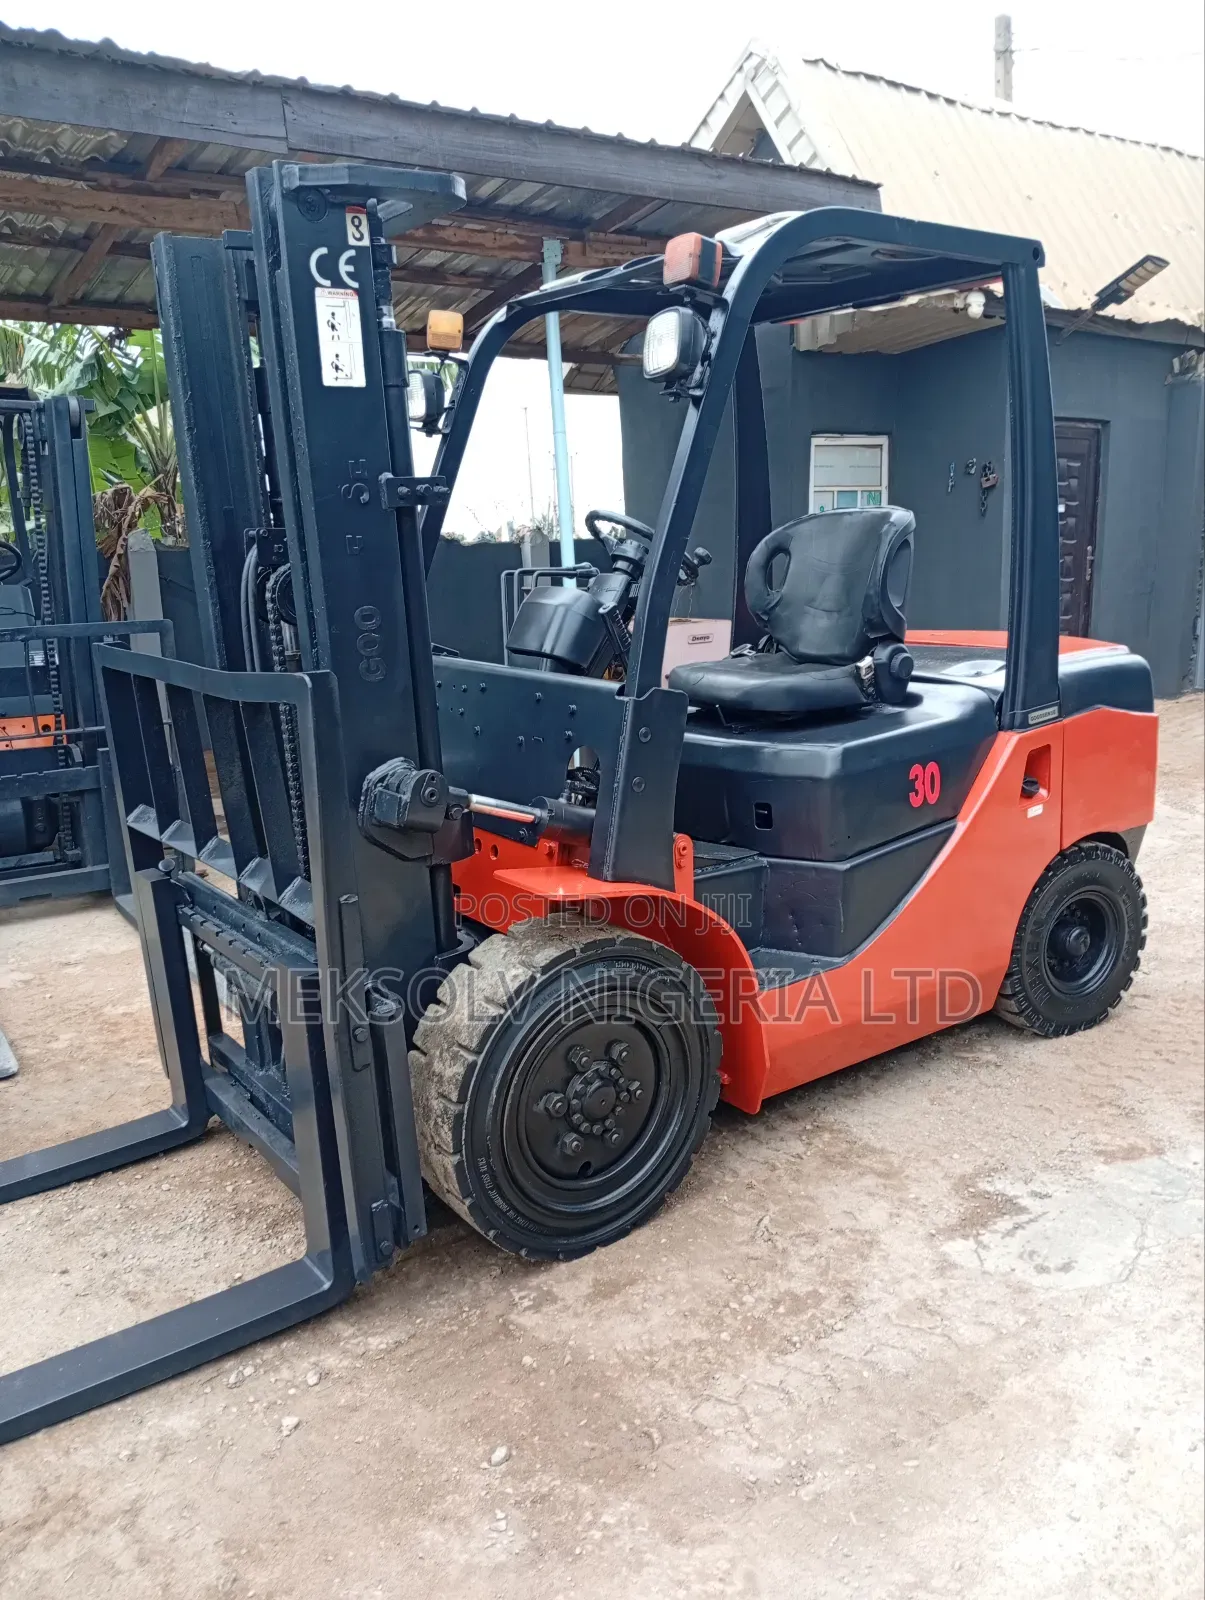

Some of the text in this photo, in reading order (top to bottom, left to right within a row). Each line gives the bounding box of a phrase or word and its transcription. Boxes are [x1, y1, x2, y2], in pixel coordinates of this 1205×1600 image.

[310, 246, 360, 289] CE
[327, 290, 354, 298] WARNING
[908, 761, 941, 808] 30
